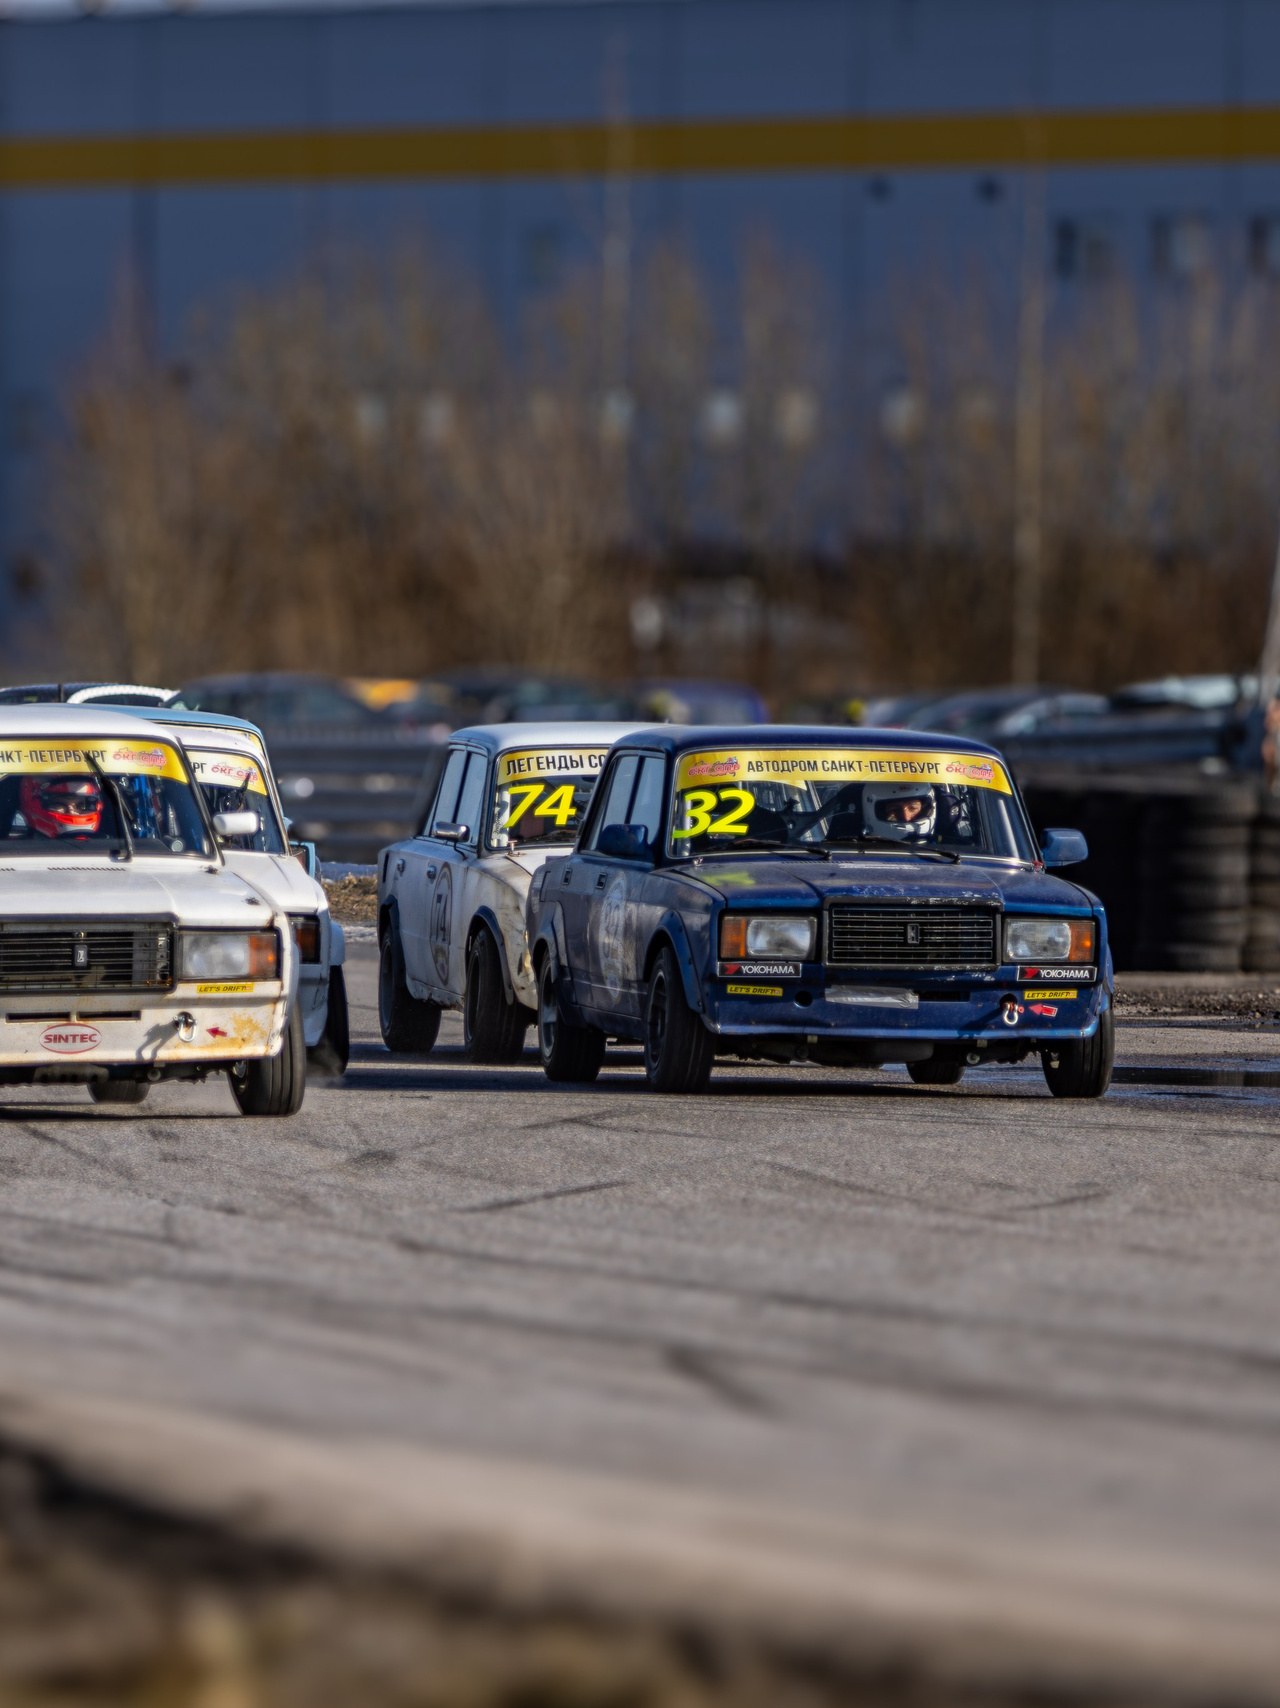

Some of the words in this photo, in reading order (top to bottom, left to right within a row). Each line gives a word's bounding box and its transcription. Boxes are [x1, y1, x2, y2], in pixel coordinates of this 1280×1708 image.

[190, 761, 206, 774] РГ
[506, 754, 584, 776] ЛЕГЕНДЫ
[747, 760, 818, 774] АВТОДРОМ
[821, 760, 941, 775] САНКТ-ПЕТЕРБУРГ
[503, 783, 577, 829] 74
[671, 787, 755, 838] 32
[740, 963, 794, 974] YOKOHAMA
[1040, 968, 1090, 979] YOKOHAMA
[199, 985, 220, 993] LET'S
[222, 984, 245, 993] DRIFT
[729, 986, 751, 994] LET'S
[43, 1033, 98, 1044] SINTEC
